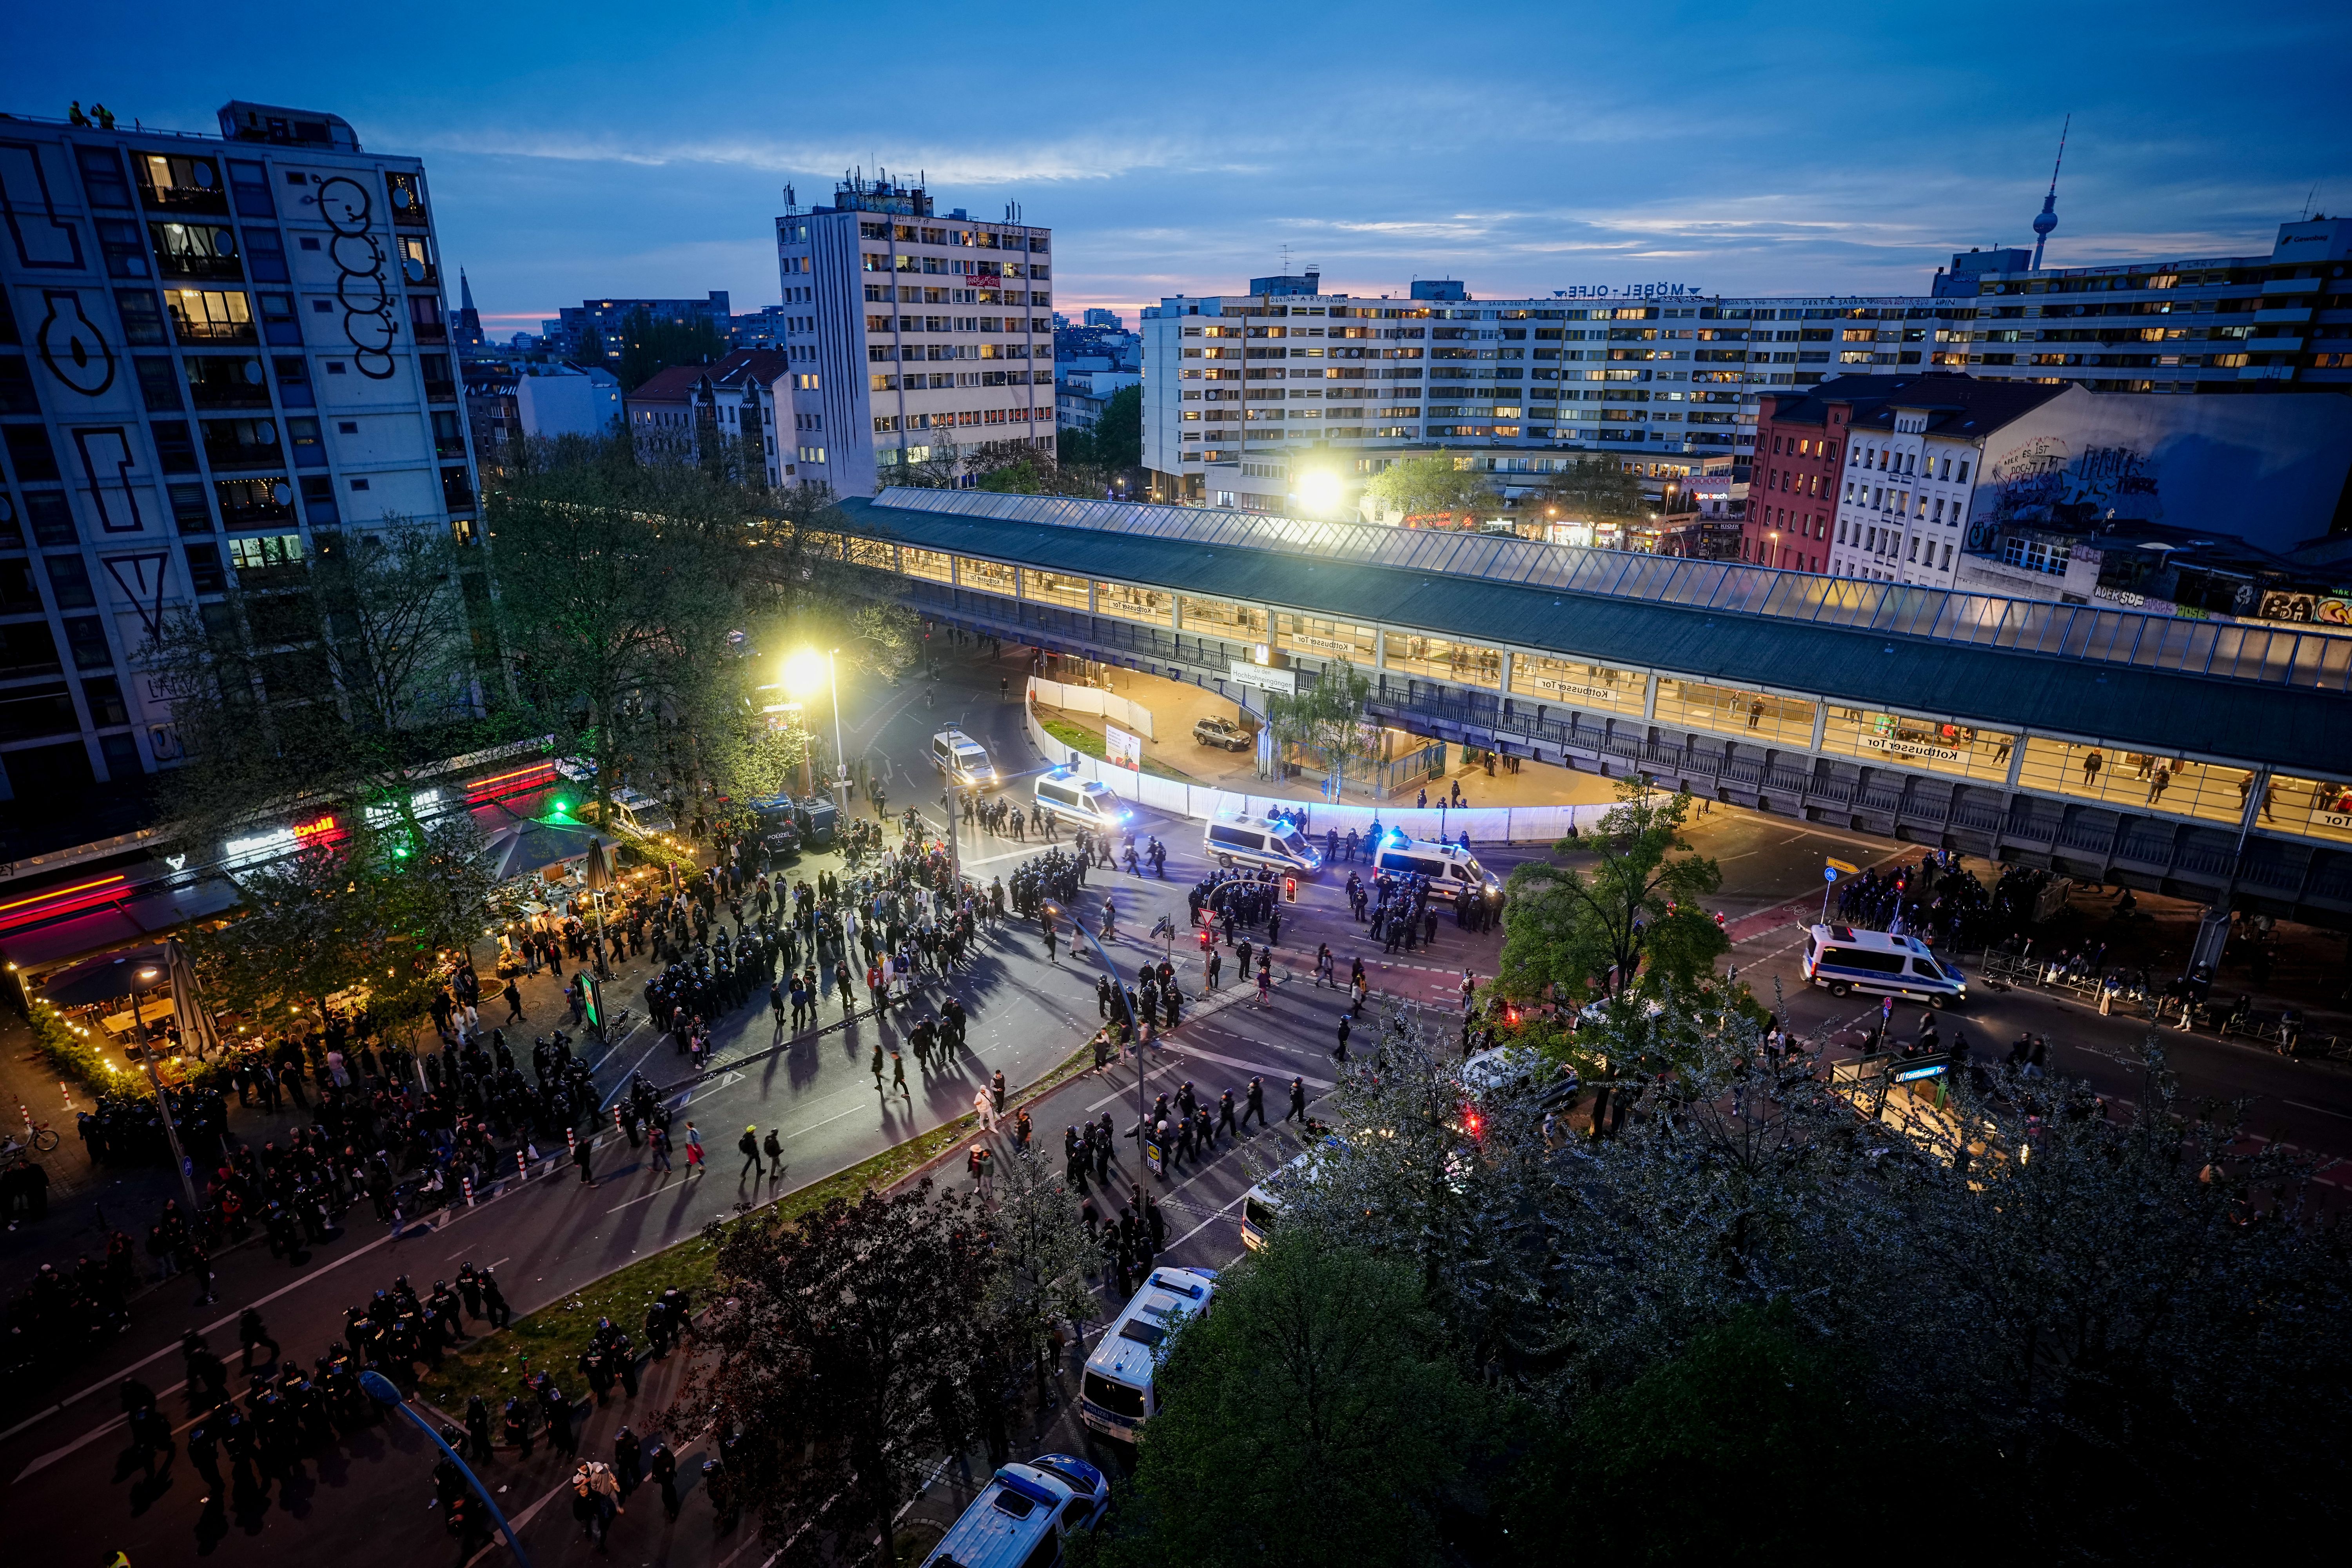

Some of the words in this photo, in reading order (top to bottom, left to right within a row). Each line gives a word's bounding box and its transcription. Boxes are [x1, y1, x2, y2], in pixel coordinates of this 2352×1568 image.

[2022, 450, 2031, 458] ES
[2094, 586, 2120, 601] ADEK
[1233, 670, 1292, 688] Hochbahneingängen
[226, 829, 297, 856] Black
[294, 817, 334, 838] bull
[767, 831, 789, 840] POLIZEI
[1905, 1068, 1935, 1080] Kottbusser
[1245, 1222, 1263, 1235] POLIZEI
[1086, 1405, 1109, 1418] POLIZEI
[1060, 1454, 1093, 1472] POLIZEI
